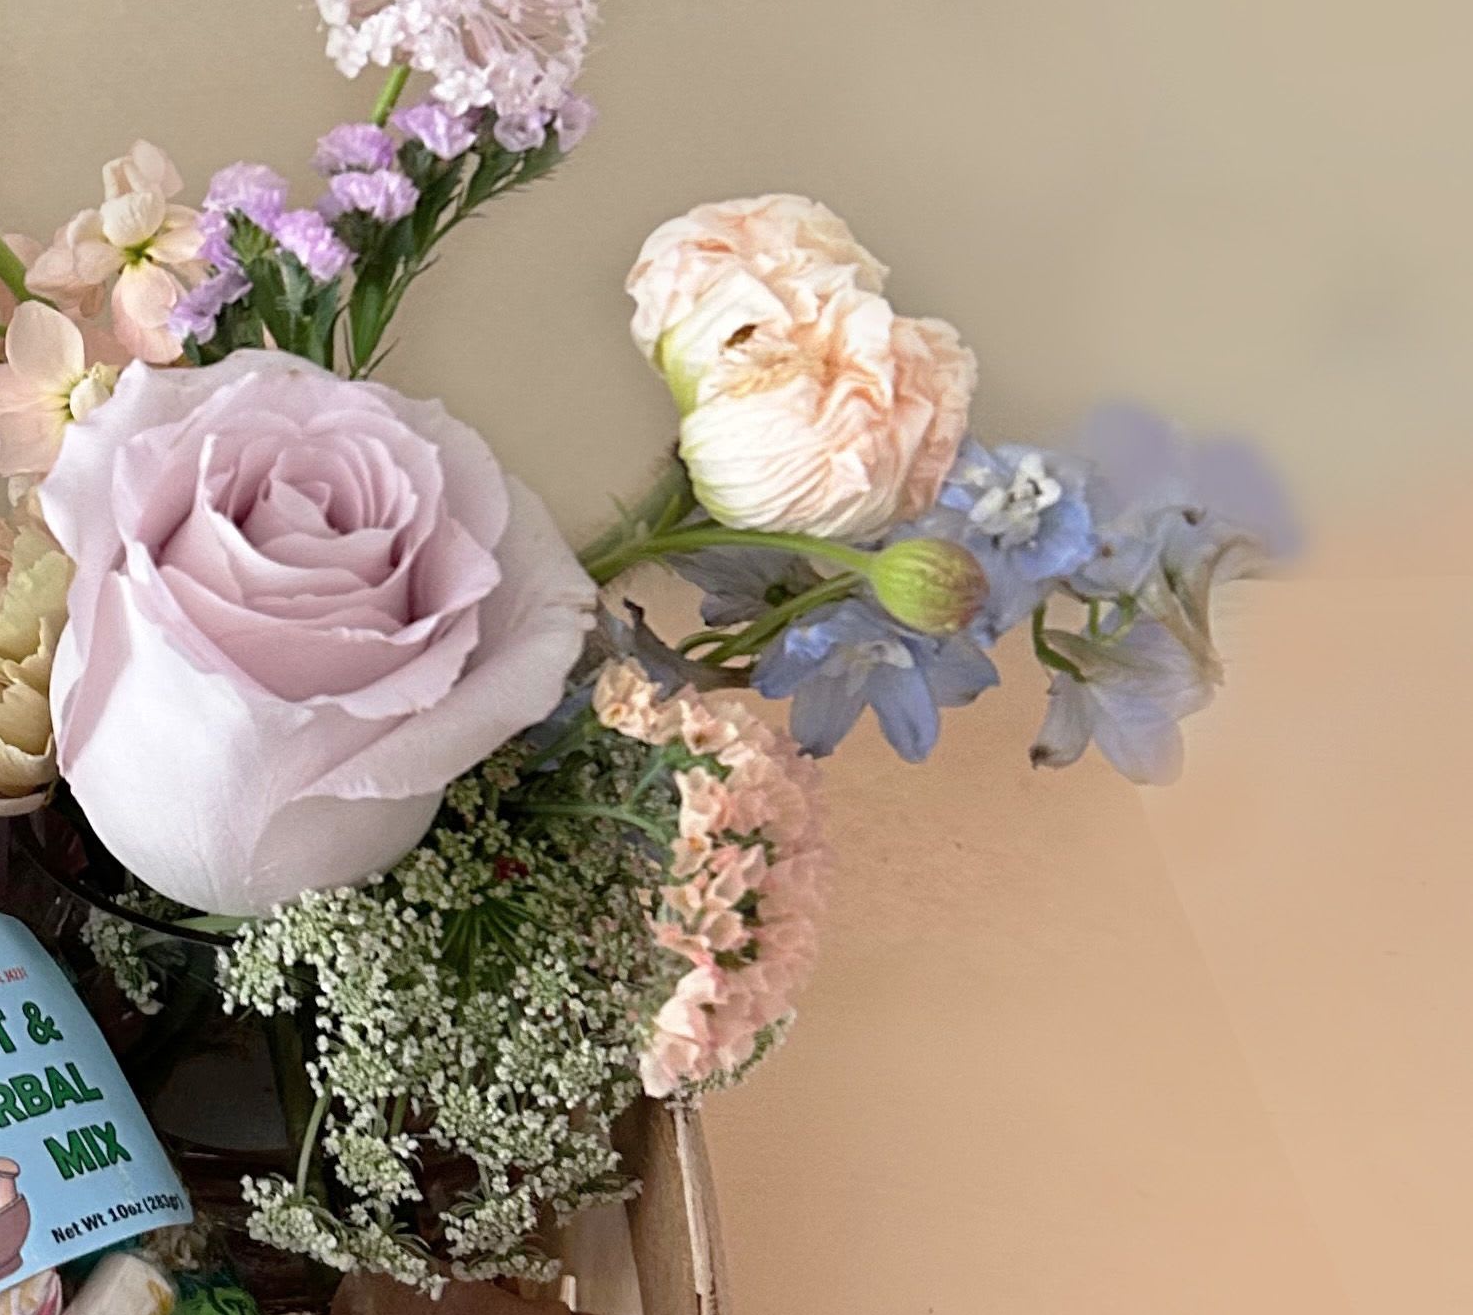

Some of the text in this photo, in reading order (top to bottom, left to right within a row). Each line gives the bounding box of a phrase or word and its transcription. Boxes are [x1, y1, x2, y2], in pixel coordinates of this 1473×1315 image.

[22, 1001, 64, 1045] &
[43, 1121, 132, 1180] MIX
[51, 1222, 83, 1244] Net
[81, 1212, 107, 1231] Wt
[108, 1201, 145, 1223] 10oz
